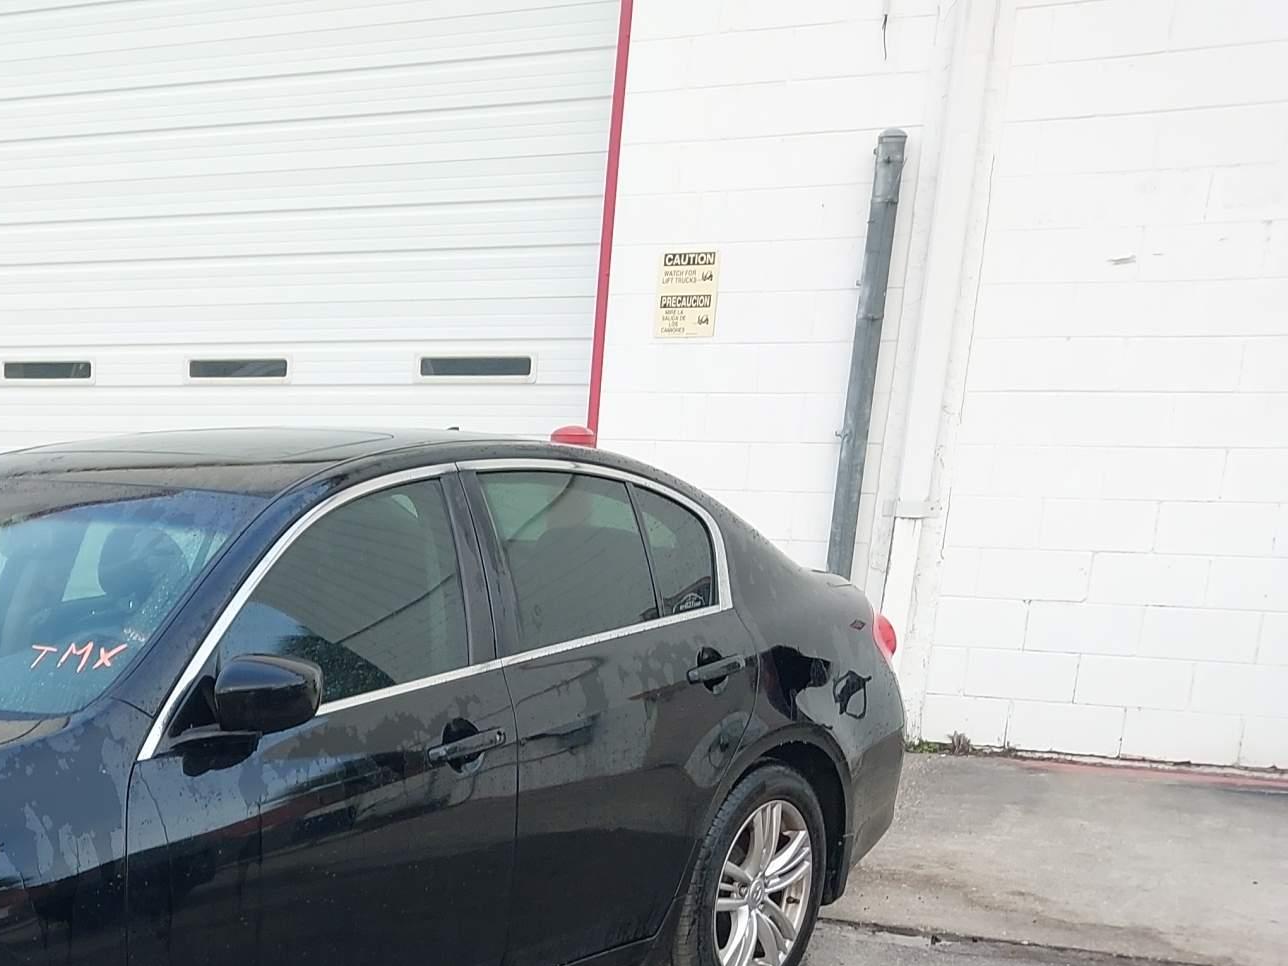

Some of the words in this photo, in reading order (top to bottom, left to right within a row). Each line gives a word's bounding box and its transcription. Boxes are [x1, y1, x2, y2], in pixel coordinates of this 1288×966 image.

[665, 253, 715, 266] CAUTION
[661, 295, 711, 308] PRECAUCION
[30, 640, 128, 673] TMX
